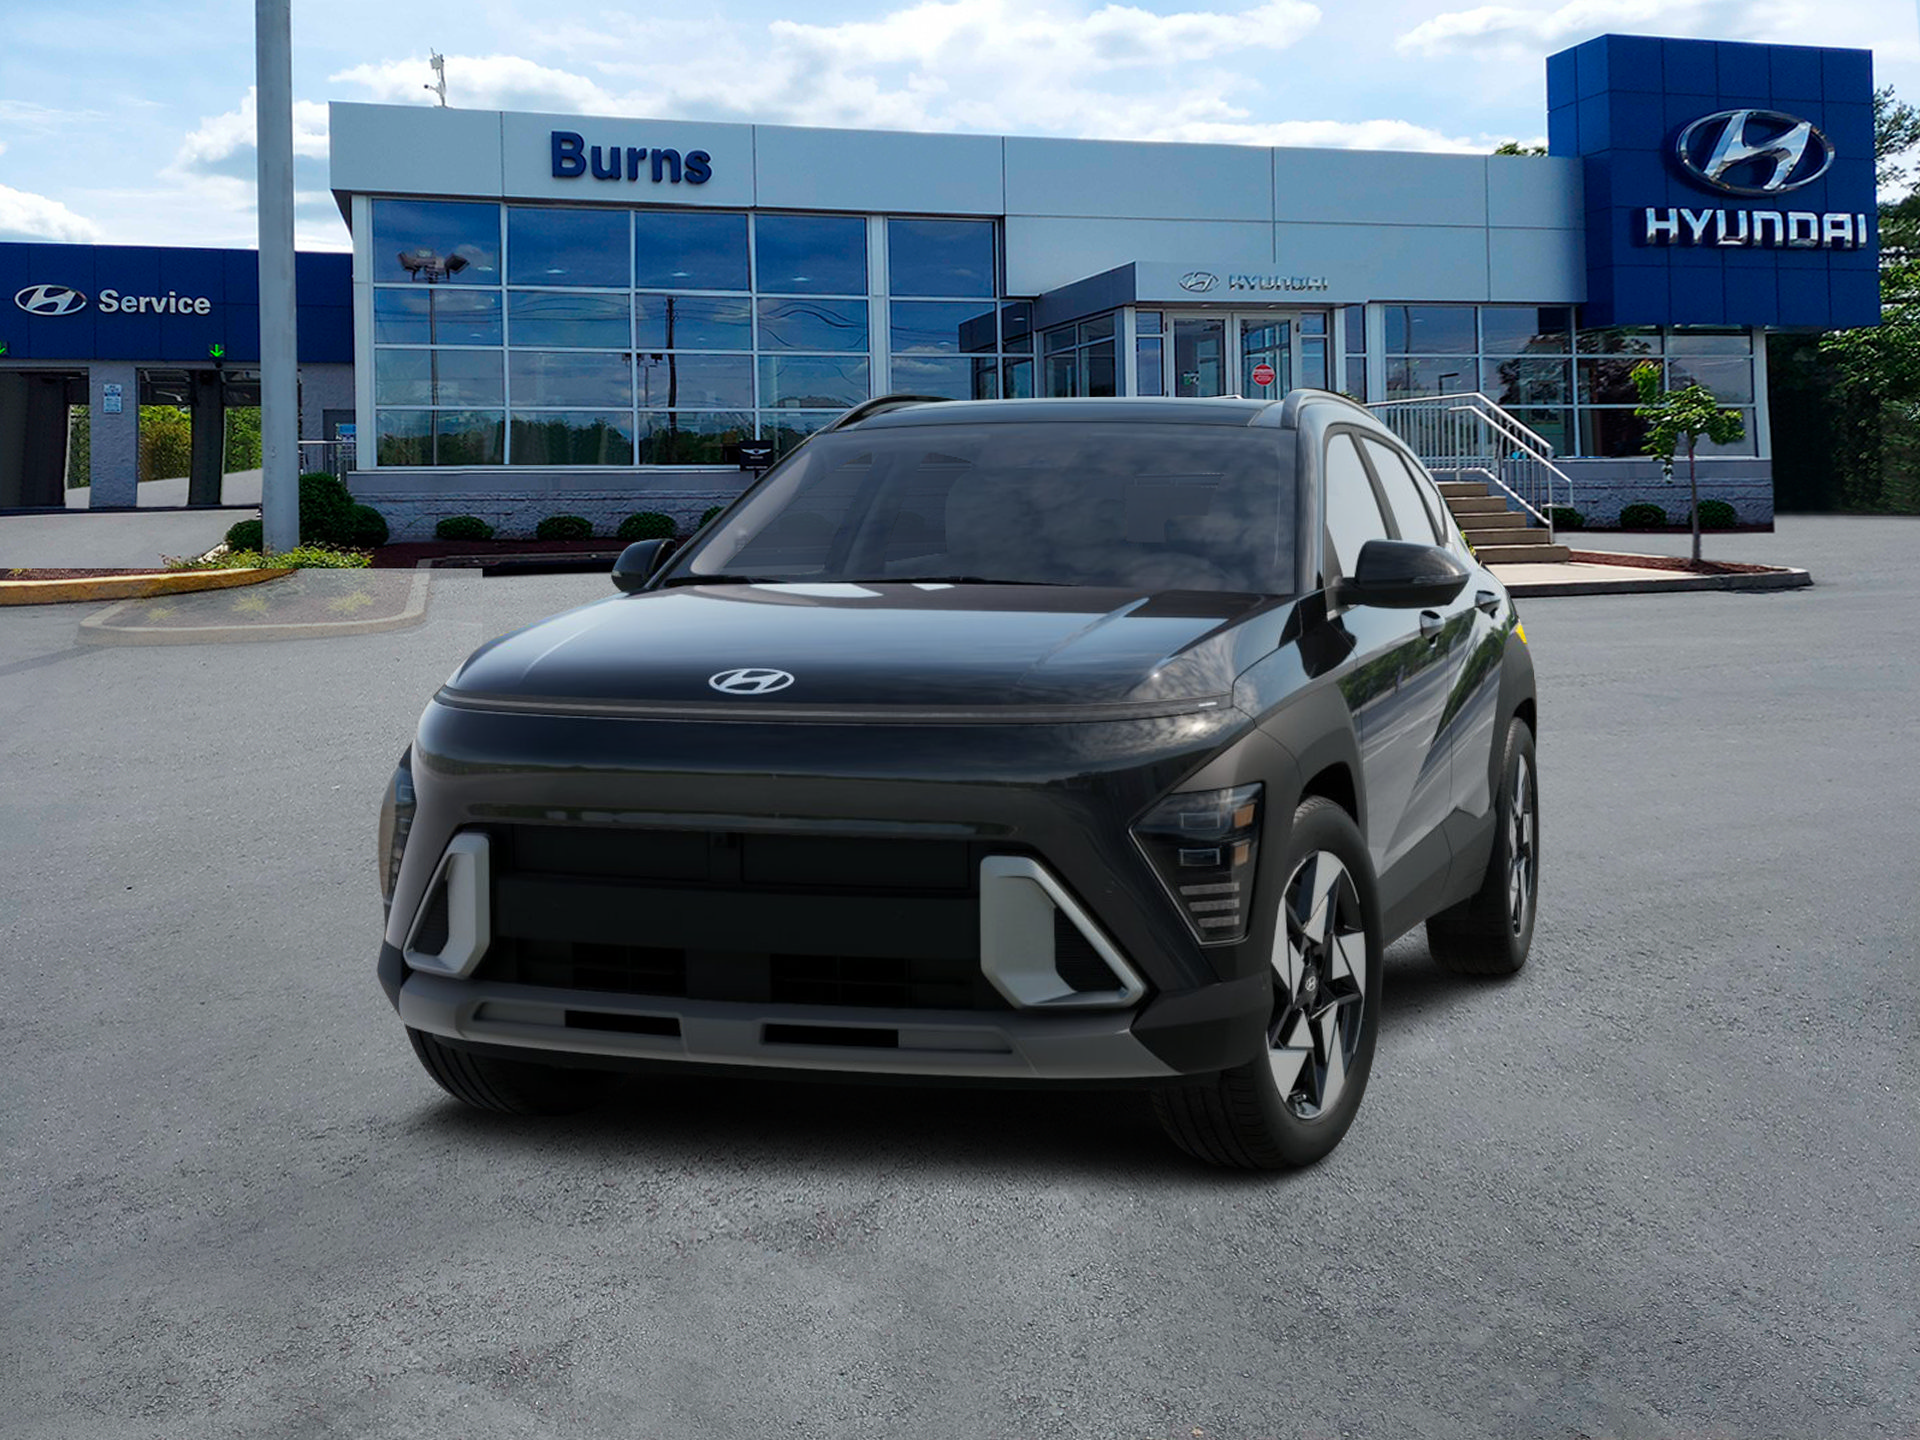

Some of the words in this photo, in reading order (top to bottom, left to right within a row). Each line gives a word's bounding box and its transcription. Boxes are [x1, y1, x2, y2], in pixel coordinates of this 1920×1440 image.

[551, 130, 712, 184] Burns
[1645, 207, 1868, 248] HYUNDAI
[1228, 274, 1328, 291] HYUNDAI
[98, 288, 212, 315] Service
